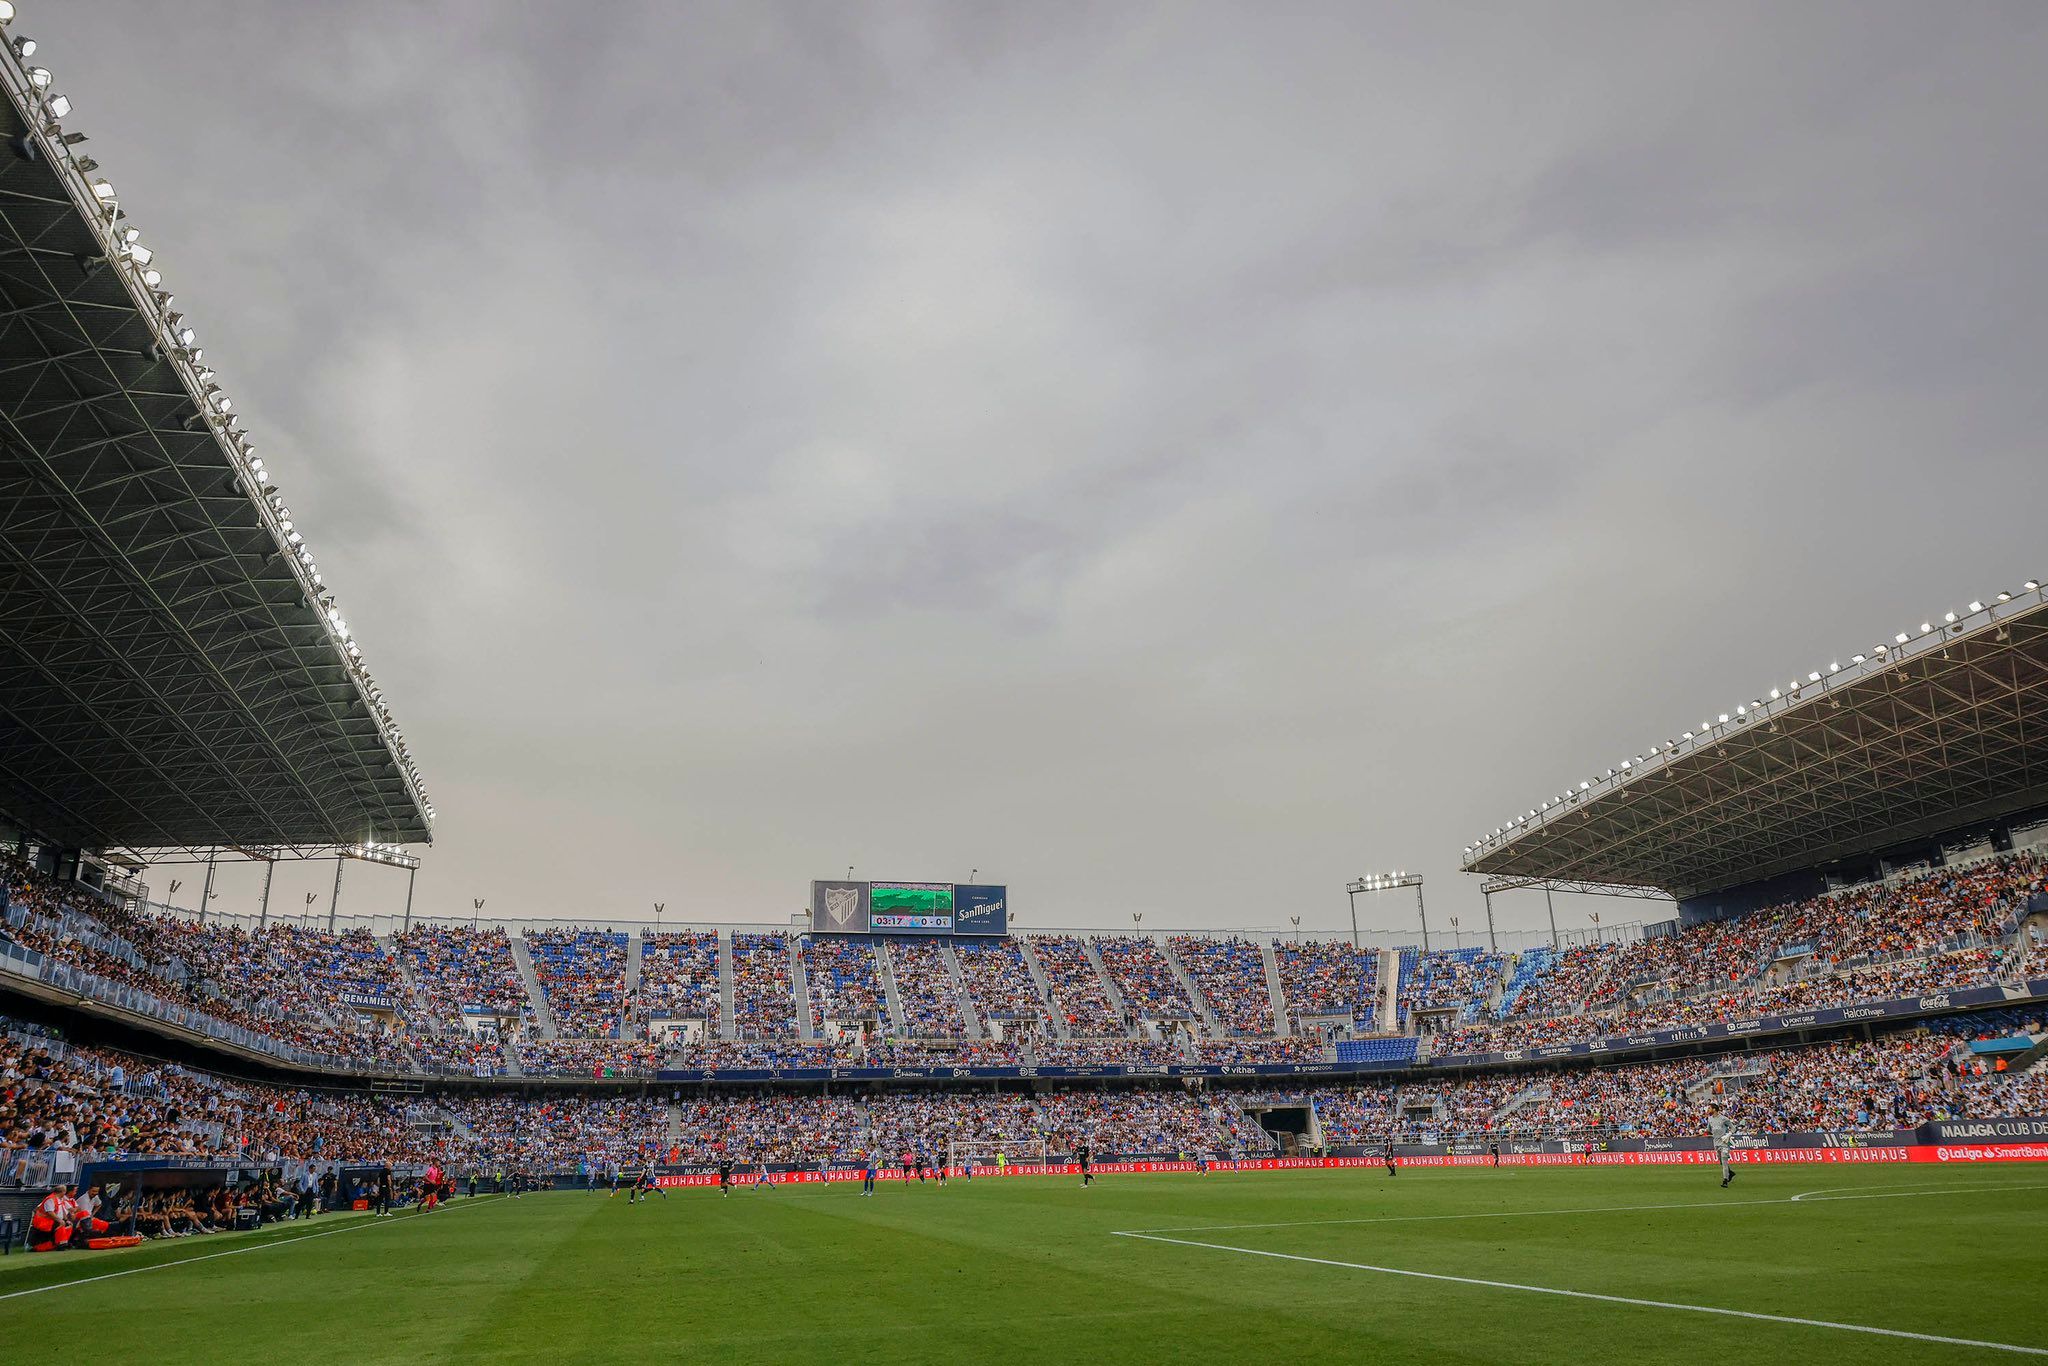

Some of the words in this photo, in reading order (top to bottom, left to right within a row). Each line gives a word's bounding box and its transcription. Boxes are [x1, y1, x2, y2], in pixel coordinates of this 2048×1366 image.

[876, 917, 903, 925] 03:17
[936, 918, 942, 926] 0
[344, 994, 391, 1006] BENAMIEL
[1589, 1041, 1607, 1050] SUR
[1231, 1066, 1256, 1074] vithas
[1997, 1122, 2030, 1136] CLUB
[1638, 1152, 1683, 1163] BAUHAUS
[1698, 1151, 1749, 1162] BAUAUS
[1766, 1150, 1823, 1161] BAUHAUS
[1843, 1148, 1908, 1161] BAUHAUS
[1949, 1147, 1983, 1161] LaLiga
[1278, 1158, 1324, 1168] BAUHAUS
[1339, 1158, 1386, 1167] BAUHAUS
[1403, 1156, 1444, 1165] BAUHAUS
[1453, 1156, 1484, 1164] BAUHAUS
[1494, 1155, 1526, 1164] AUHAUS
[1536, 1155, 1573, 1164] BAUHAUS
[1018, 1165, 1068, 1174] BAUHAUS
[1152, 1162, 1197, 1171] BAUHAU
[878, 1169, 931, 1179] BAUAS
[949, 1167, 1001, 1177] BAHAUS
[655, 1177, 712, 1187] BAUHAUS
